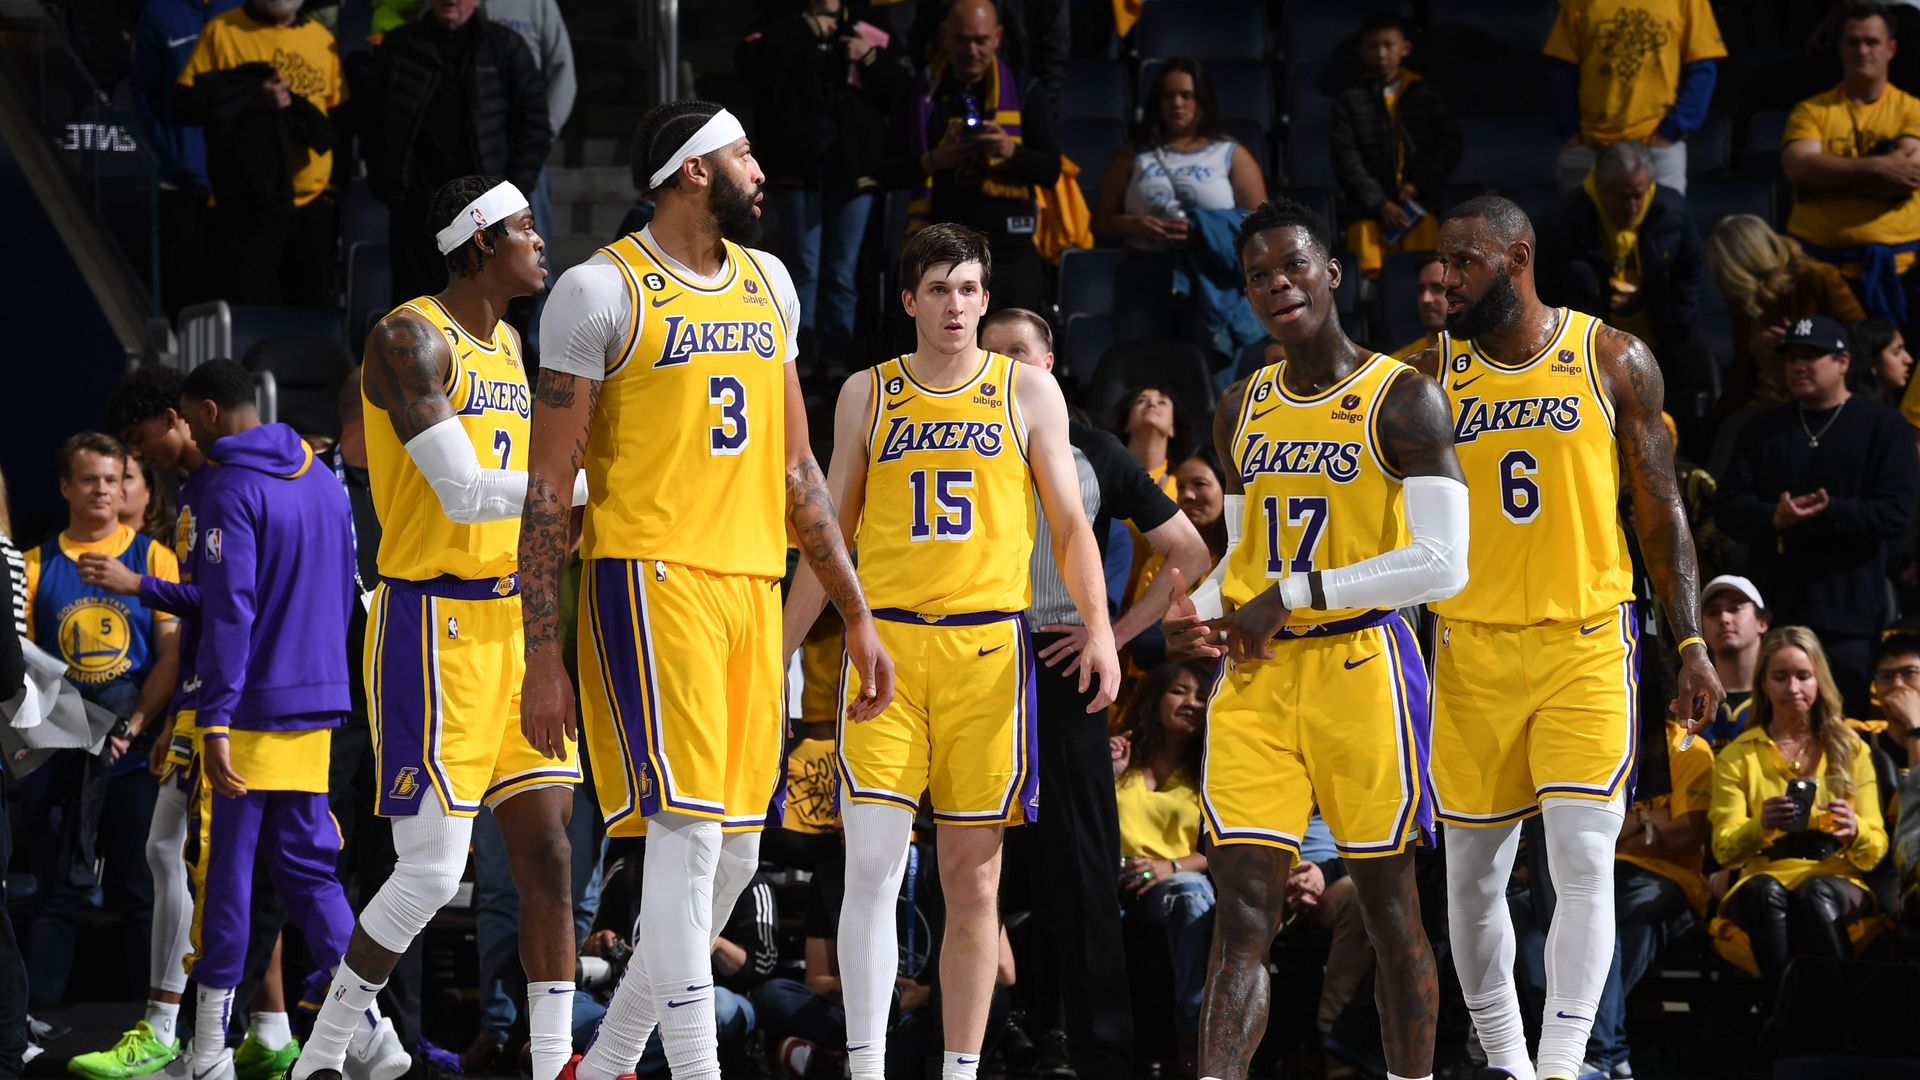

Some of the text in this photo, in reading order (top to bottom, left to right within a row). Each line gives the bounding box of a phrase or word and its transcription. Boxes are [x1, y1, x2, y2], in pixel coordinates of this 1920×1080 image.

[646, 274, 662, 290] 6
[742, 294, 768, 306] bibigo
[652, 315, 776, 369] LAKERS
[1456, 356, 1467, 371] 6
[1551, 364, 1582, 375] bibigo
[456, 370, 530, 420] LAKERS
[889, 379, 901, 394] 6
[1257, 384, 1268, 400] 6
[973, 396, 1003, 408] bibigo
[708, 375, 749, 456] 3
[1331, 411, 1363, 424] bibigo
[1454, 395, 1582, 446] LAKERS
[877, 416, 1004, 464] LAKERS
[1241, 432, 1364, 485] LAKERS
[1498, 449, 1542, 525] 6
[909, 470, 975, 542] 15
[1263, 496, 1330, 579] 17
[100, 617, 112, 636] 5
[65, 657, 132, 683] WARRIORS
